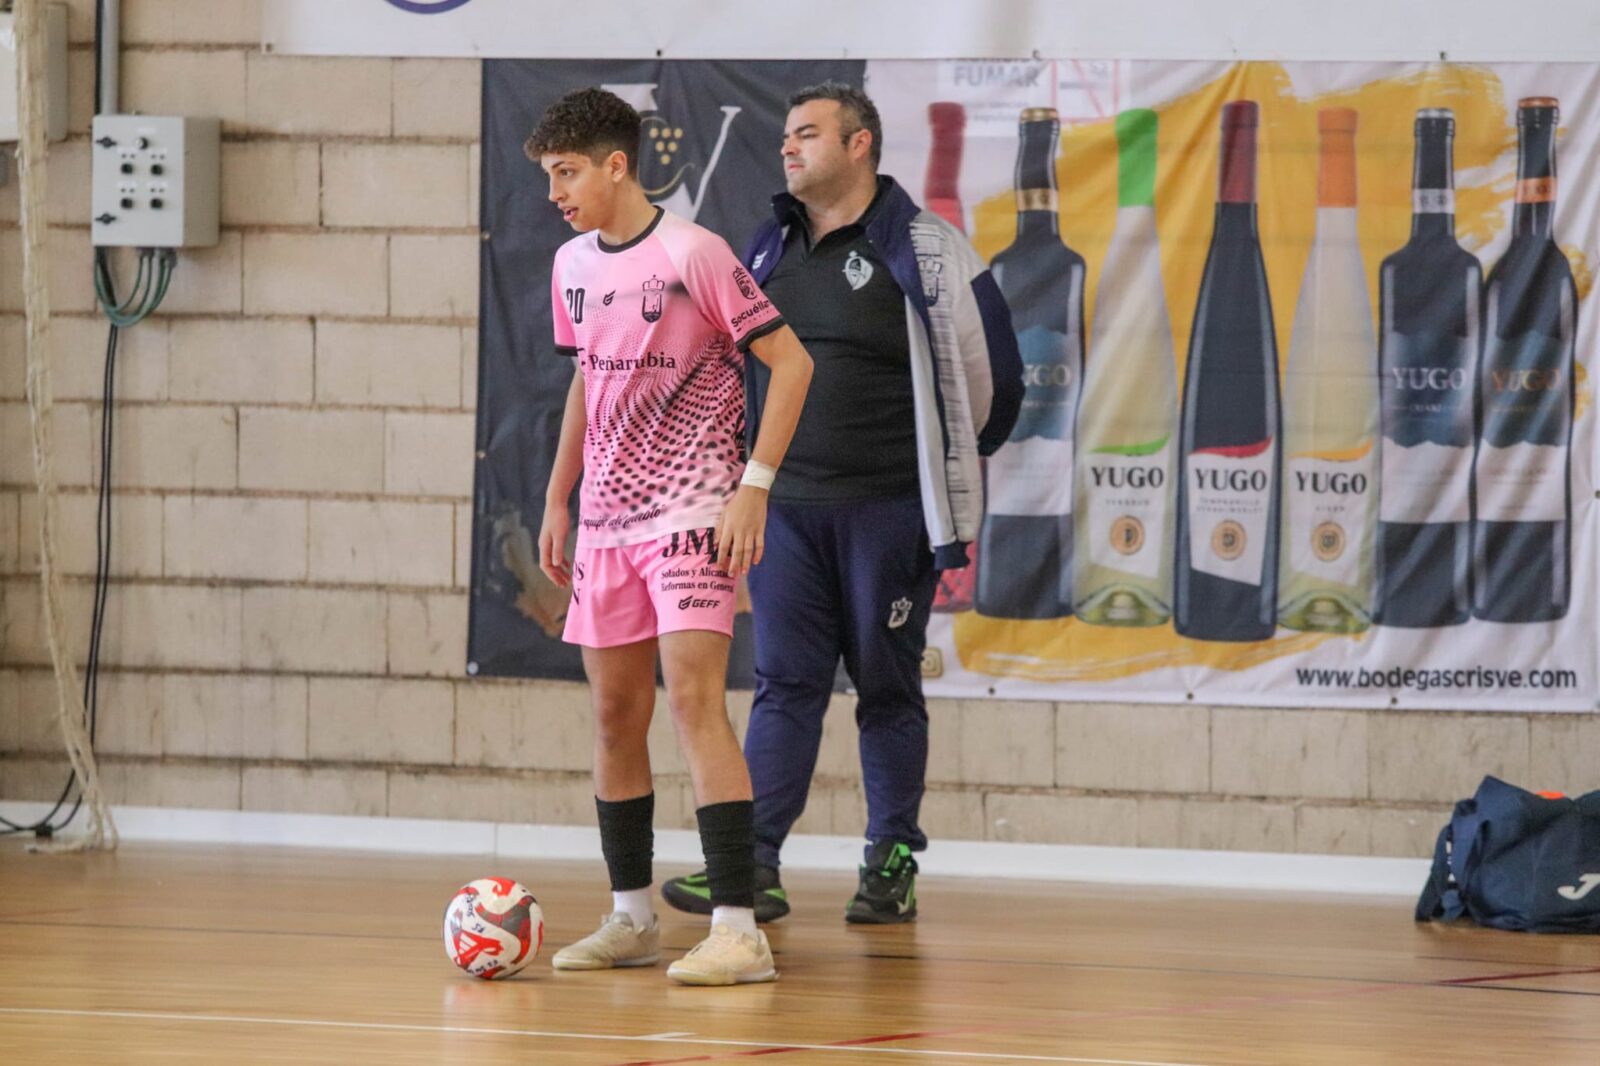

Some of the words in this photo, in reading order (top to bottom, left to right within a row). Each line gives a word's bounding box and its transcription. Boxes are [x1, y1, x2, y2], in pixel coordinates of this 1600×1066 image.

[954, 65, 1039, 87] FUMAR
[566, 288, 585, 324] 20
[589, 352, 676, 371] Peñarubia
[1392, 367, 1467, 390] YUGO
[1491, 368, 1562, 392] YUGO
[1091, 466, 1164, 488] YUGO
[1195, 468, 1267, 492] YUGO
[1296, 471, 1367, 494] YUGO
[691, 569, 698, 578] y
[692, 599, 720, 609] GEFF
[1296, 666, 1577, 690] www.bodegascrisve.com
